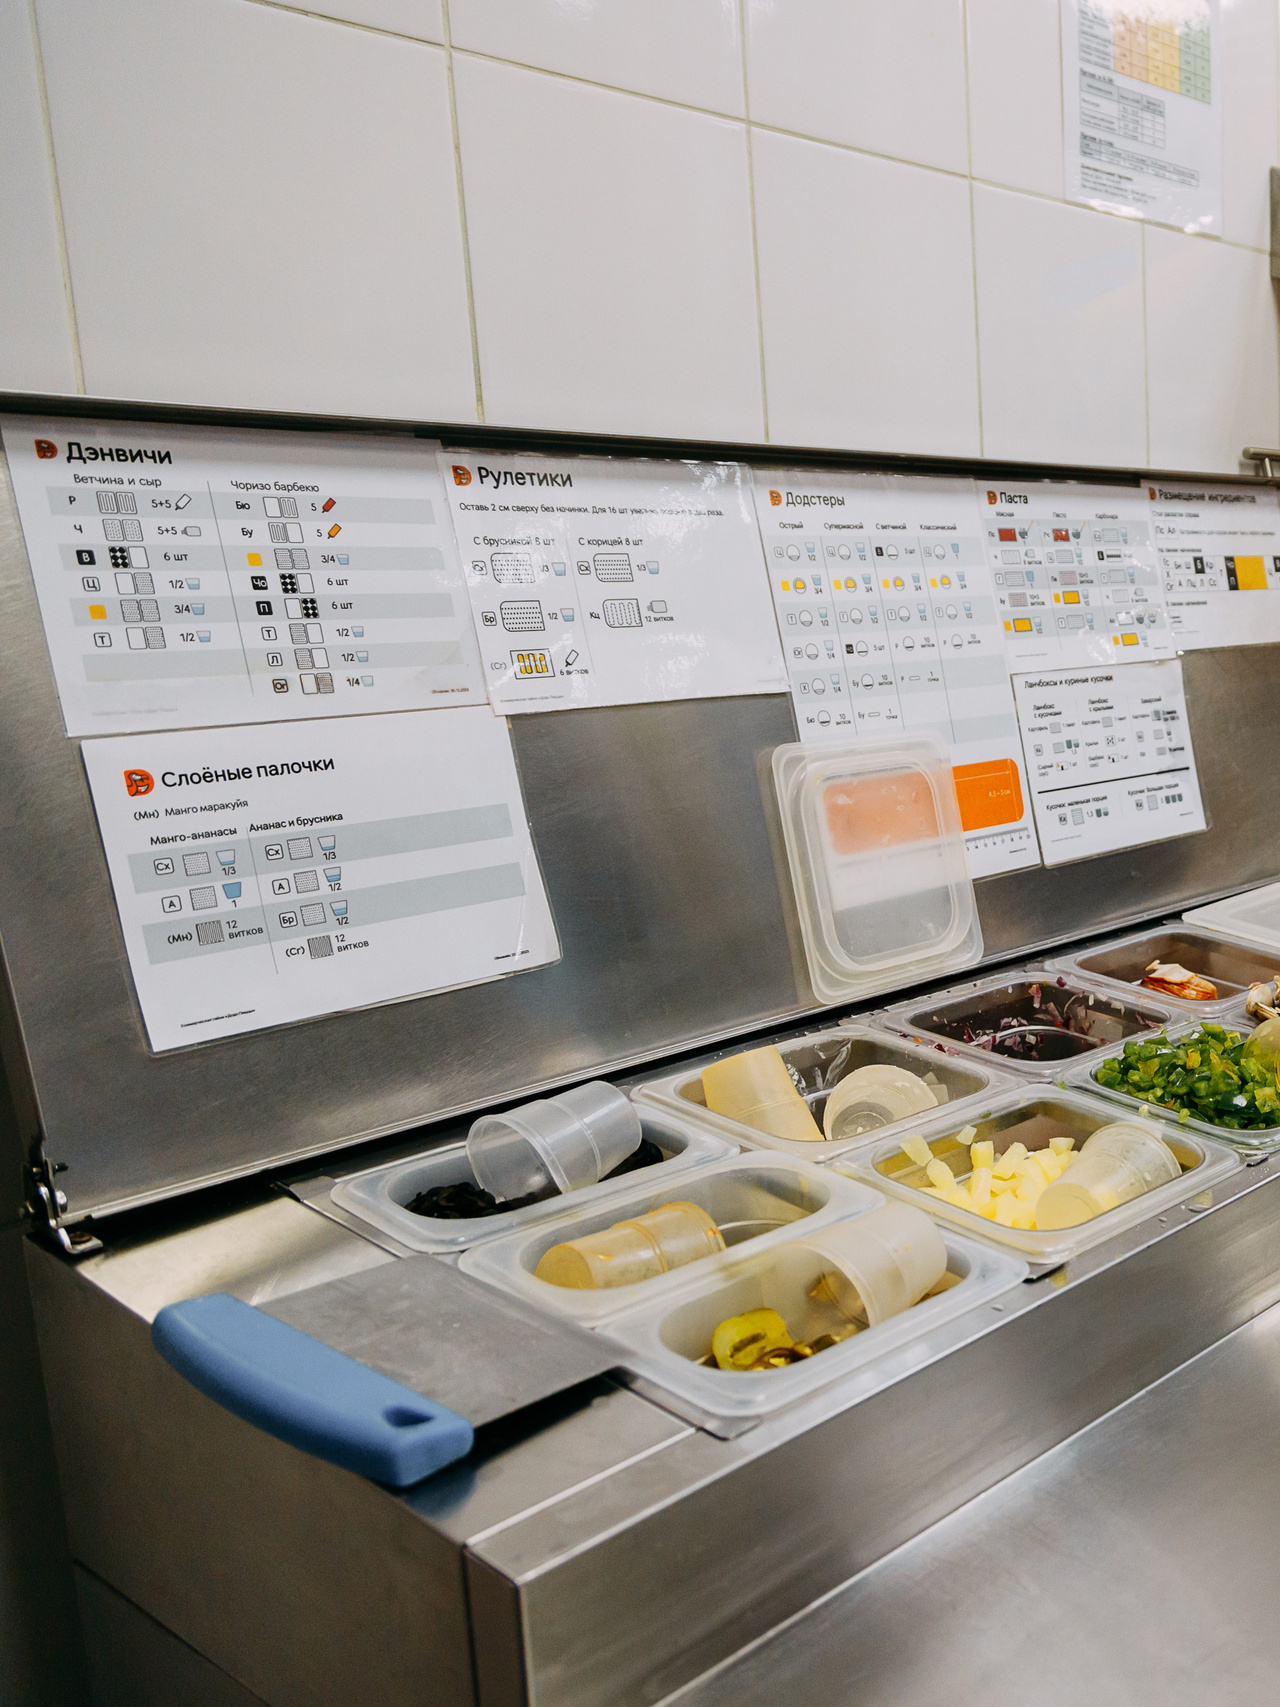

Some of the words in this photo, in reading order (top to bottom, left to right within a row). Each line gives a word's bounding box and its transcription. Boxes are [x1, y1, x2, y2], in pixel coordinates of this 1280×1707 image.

[66, 442, 172, 465] Дэнвичи
[73, 474, 124, 486] Ветчина
[128, 477, 136, 486] и
[139, 477, 162, 488] сыр
[477, 465, 573, 489] Рулетики
[230, 480, 271, 491] Чоризо
[274, 481, 320, 493] барбекю
[786, 492, 845, 508] Додстеры
[999, 492, 1028, 504] Паста
[151, 499, 172, 508] 5+5
[236, 500, 251, 510] Бю
[310, 503, 317, 512] 5
[459, 503, 489, 512] Оставь
[490, 504, 497, 512] 2
[512, 505, 538, 514] сверху
[540, 504, 554, 513] без
[592, 506, 607, 515] Для
[608, 506, 618, 514] 16
[74, 524, 84, 534] Ч
[157, 526, 178, 536] 5+5
[779, 522, 804, 530] Острый
[241, 528, 254, 538] Бу
[316, 529, 322, 538] 5
[543, 538, 555, 546] шт
[578, 536, 585, 546] С
[587, 536, 623, 547] корицей
[624, 537, 630, 546] 8
[632, 538, 643, 546] шт
[164, 552, 171, 561] 6
[174, 554, 188, 562] шт
[321, 554, 336, 564] 3/4
[541, 564, 550, 572] /3
[636, 564, 646, 572] 1/3
[87, 578, 98, 590] Ц
[168, 580, 184, 590] 1/2
[327, 578, 334, 586] 6
[336, 578, 349, 586] шт
[174, 604, 191, 614] 3/4
[332, 602, 338, 610] 6
[340, 602, 354, 610] шт
[484, 614, 494, 624] Бр
[548, 612, 558, 620] 1/2
[590, 612, 600, 620] Кц
[180, 633, 196, 642] 1/2
[265, 630, 272, 638] Т
[336, 628, 350, 637] 1/2
[98, 636, 106, 645] Т
[270, 655, 279, 664] Л
[341, 653, 356, 662] 1/2
[560, 668, 564, 676] 6
[566, 668, 589, 676] виков
[274, 682, 286, 691] Ог
[346, 678, 360, 687] 1/4
[161, 766, 253, 788] Слоёные
[256, 758, 335, 778] палочки
[133, 808, 160, 822] (Мн)
[164, 805, 198, 818] Манго
[200, 799, 248, 814] маракуйя
[249, 818, 287, 833] Ананас
[288, 820, 295, 828] и
[296, 812, 344, 828] брусника
[150, 826, 238, 846] Манго-ананасы
[266, 848, 280, 857] Сх
[323, 851, 337, 860] 1/3
[156, 862, 171, 872] Сх
[222, 866, 237, 876] 1/3
[328, 882, 342, 892] 1/2
[232, 900, 238, 908] 1
[226, 920, 238, 930] 12
[281, 916, 295, 926] Бр
[336, 916, 350, 926] 1/2
[228, 926, 264, 940] витков
[167, 932, 194, 945] (Мн)
[334, 934, 346, 943] 12
[336, 940, 370, 953] витков
[285, 946, 306, 958] (Сг)
